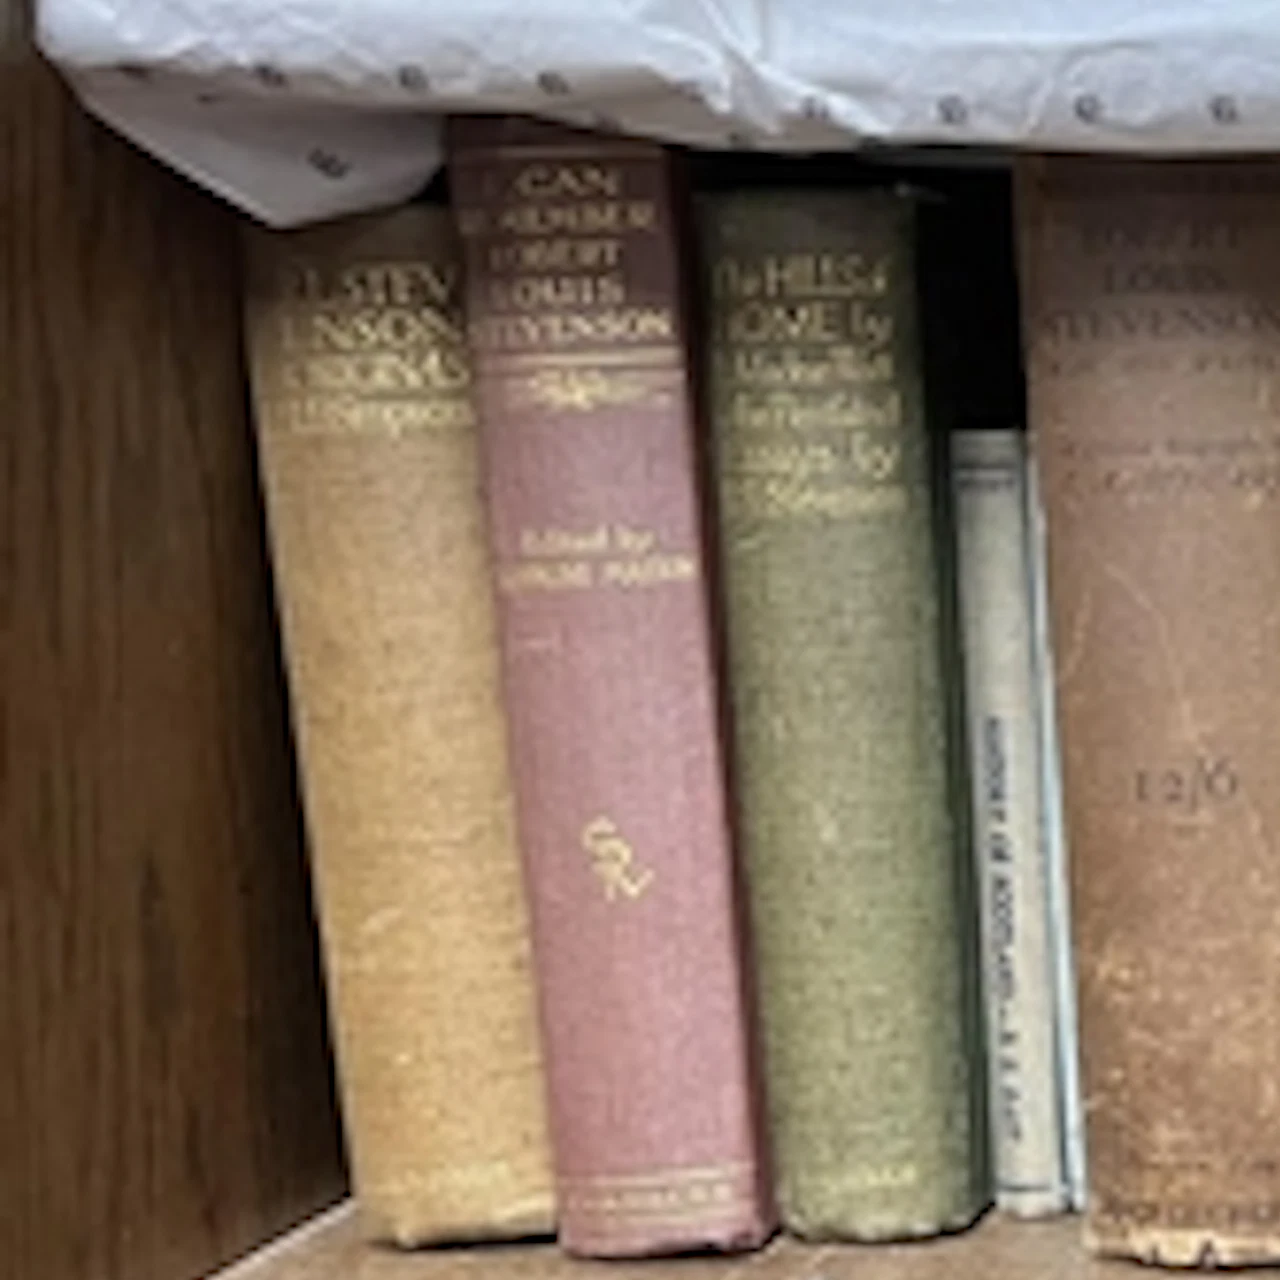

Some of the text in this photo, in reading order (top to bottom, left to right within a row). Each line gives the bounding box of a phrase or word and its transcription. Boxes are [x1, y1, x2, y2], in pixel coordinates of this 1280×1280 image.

[515, 164, 618, 198] CAN
[489, 274, 625, 310] LOUIS
[467, 308, 674, 348] STEVENSON
